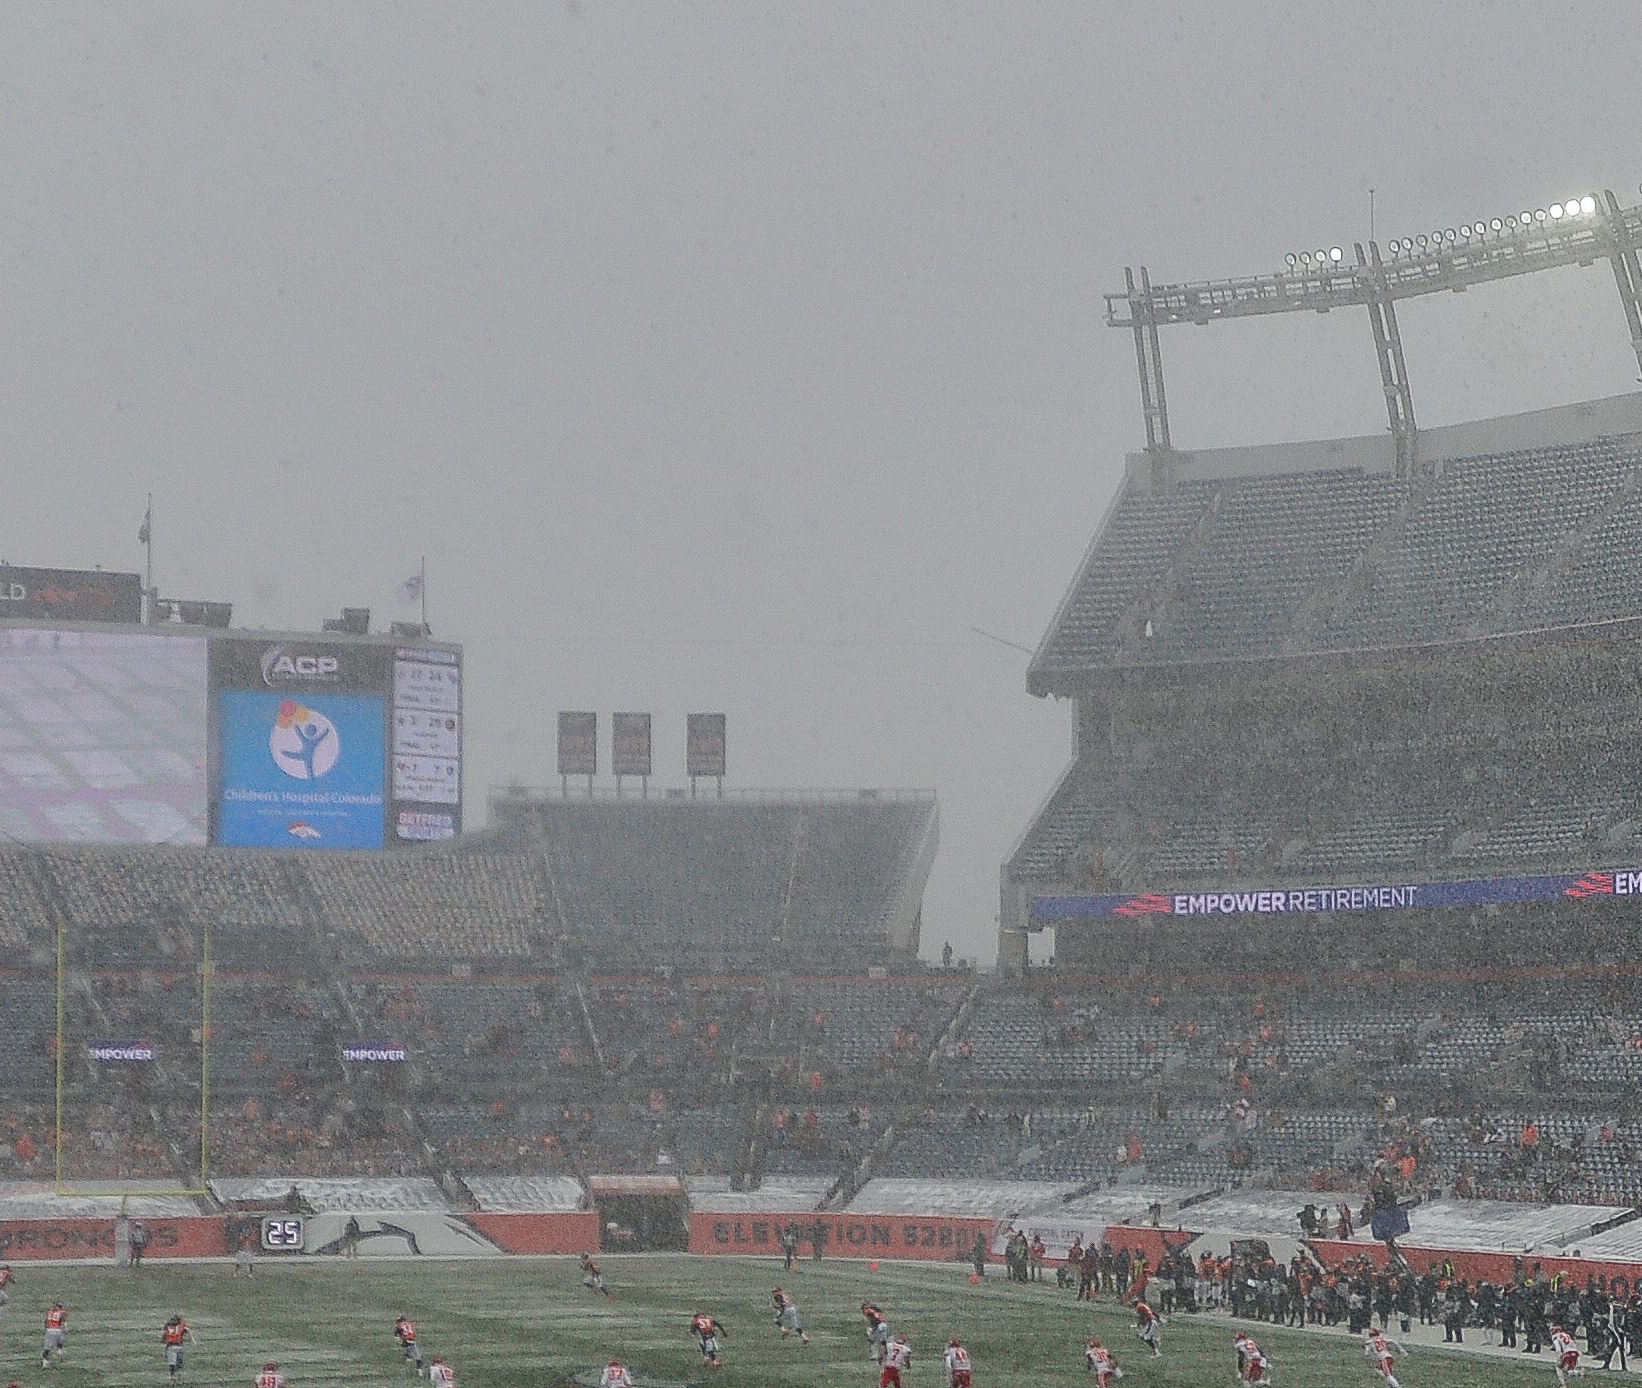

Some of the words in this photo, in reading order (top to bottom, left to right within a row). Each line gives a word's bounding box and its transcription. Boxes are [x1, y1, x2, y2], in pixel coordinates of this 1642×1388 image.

[274, 655, 338, 675] ACP
[1174, 891, 1287, 915] EMPOWER
[1288, 885, 1418, 912] RETIREMENT
[91, 1048, 152, 1061] MPOWER
[268, 1222, 299, 1245] 25
